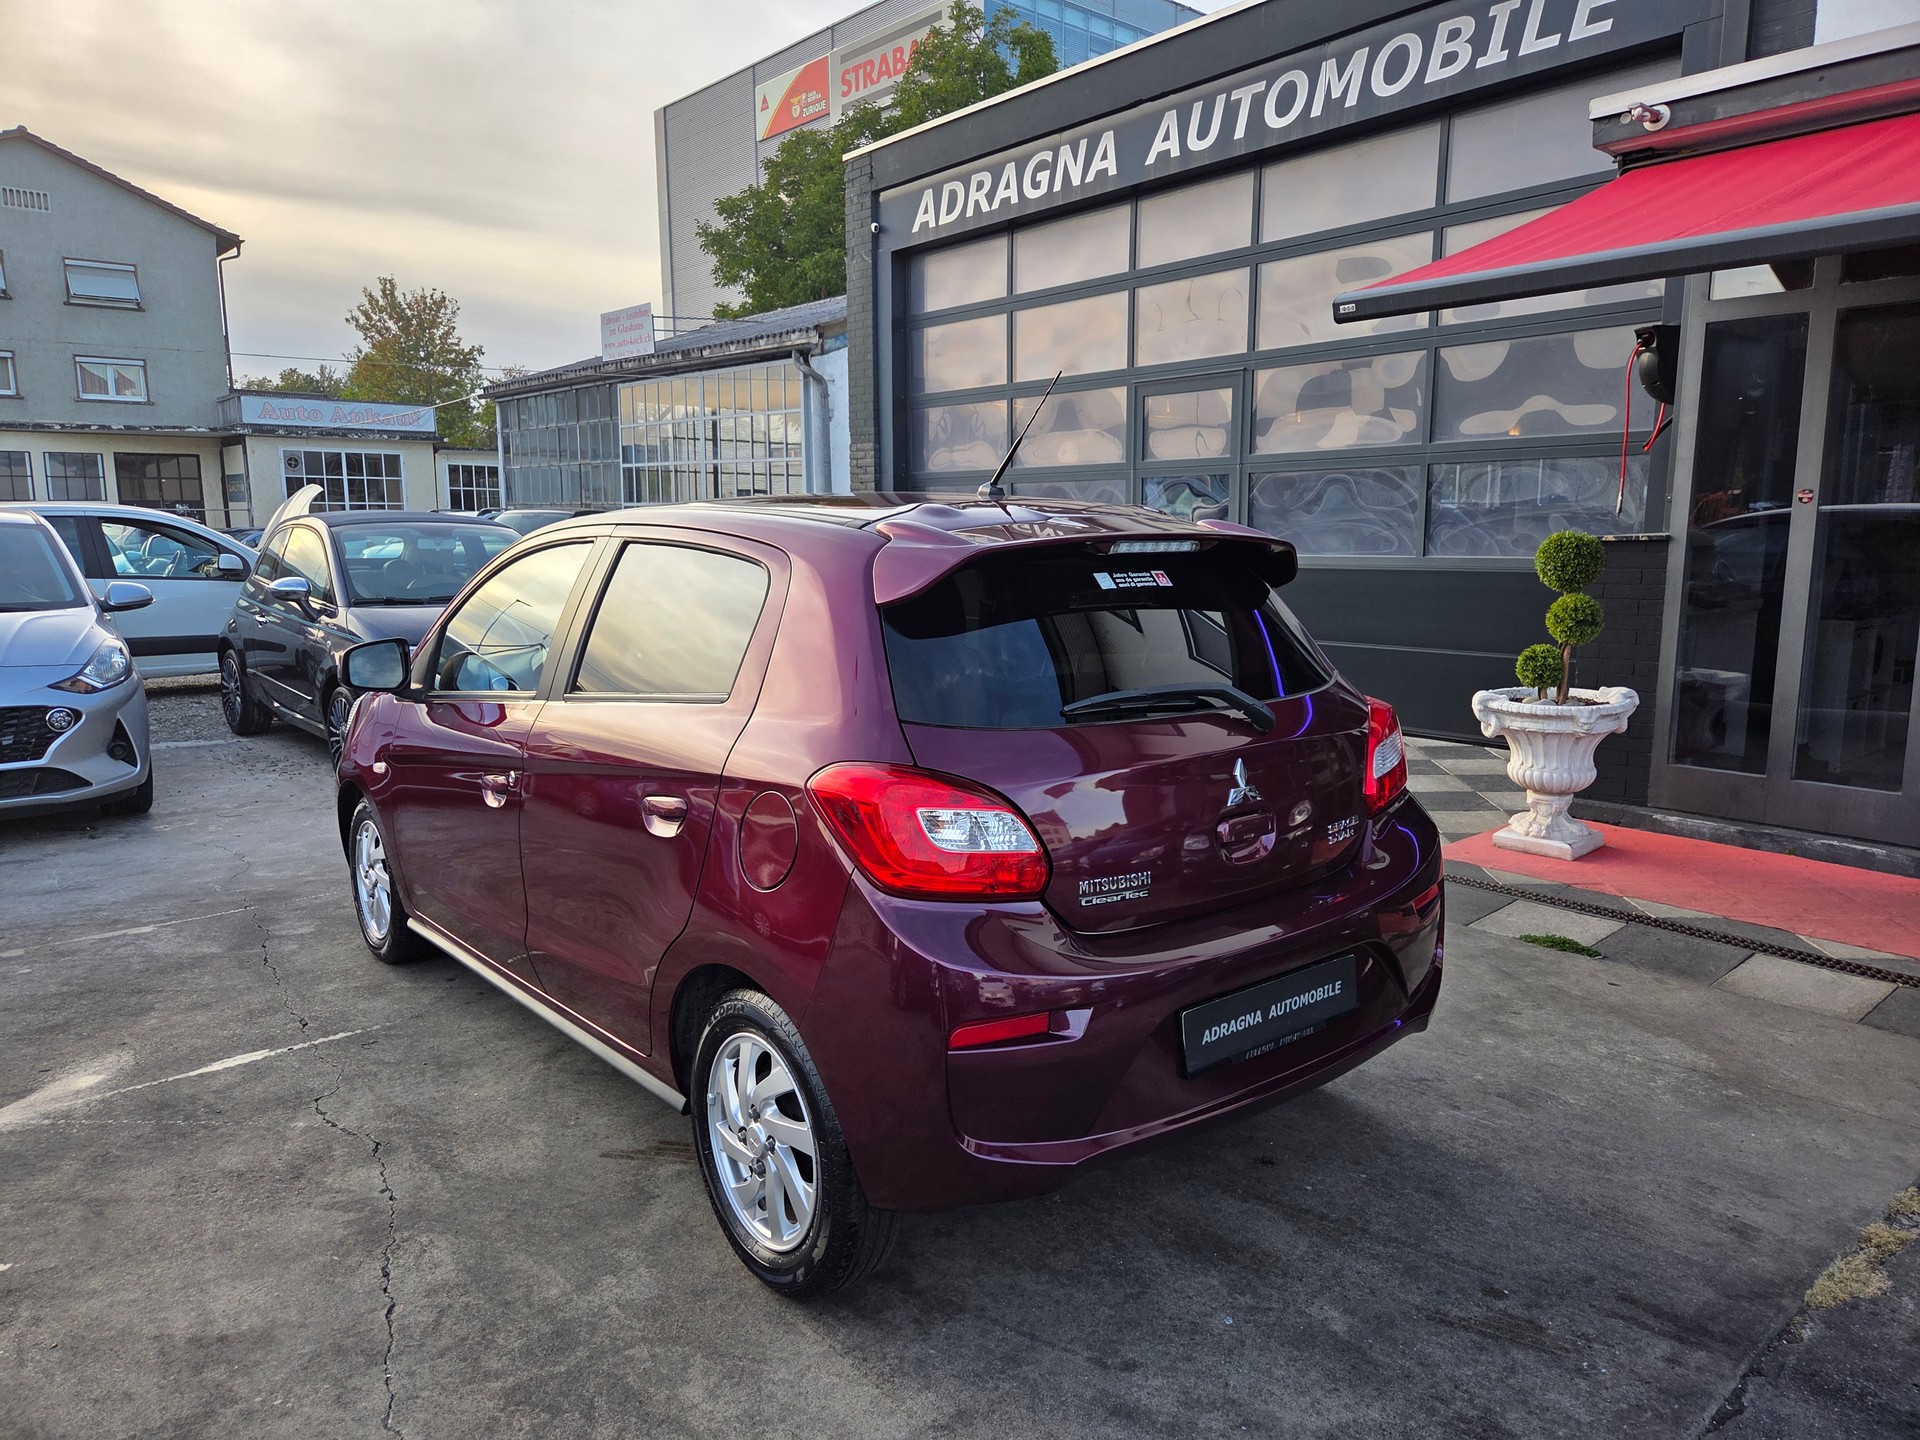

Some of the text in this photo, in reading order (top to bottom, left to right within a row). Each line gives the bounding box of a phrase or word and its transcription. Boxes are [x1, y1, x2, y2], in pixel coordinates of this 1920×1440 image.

[802, 100, 827, 118] ZURIQUE
[912, 0, 1617, 233] ADRAGNA AUTOMOBILE
[609, 322, 644, 336] im Glashaus
[604, 332, 651, 349] www.auto-koch.ch
[258, 401, 421, 427] Auto Ankauf
[1079, 870, 1151, 895] MITSUBISHI
[1080, 890, 1149, 906] ClearTec
[1201, 1010, 1263, 1046] ADRAGNA
[1268, 980, 1342, 1020] AUTOMOBILE
